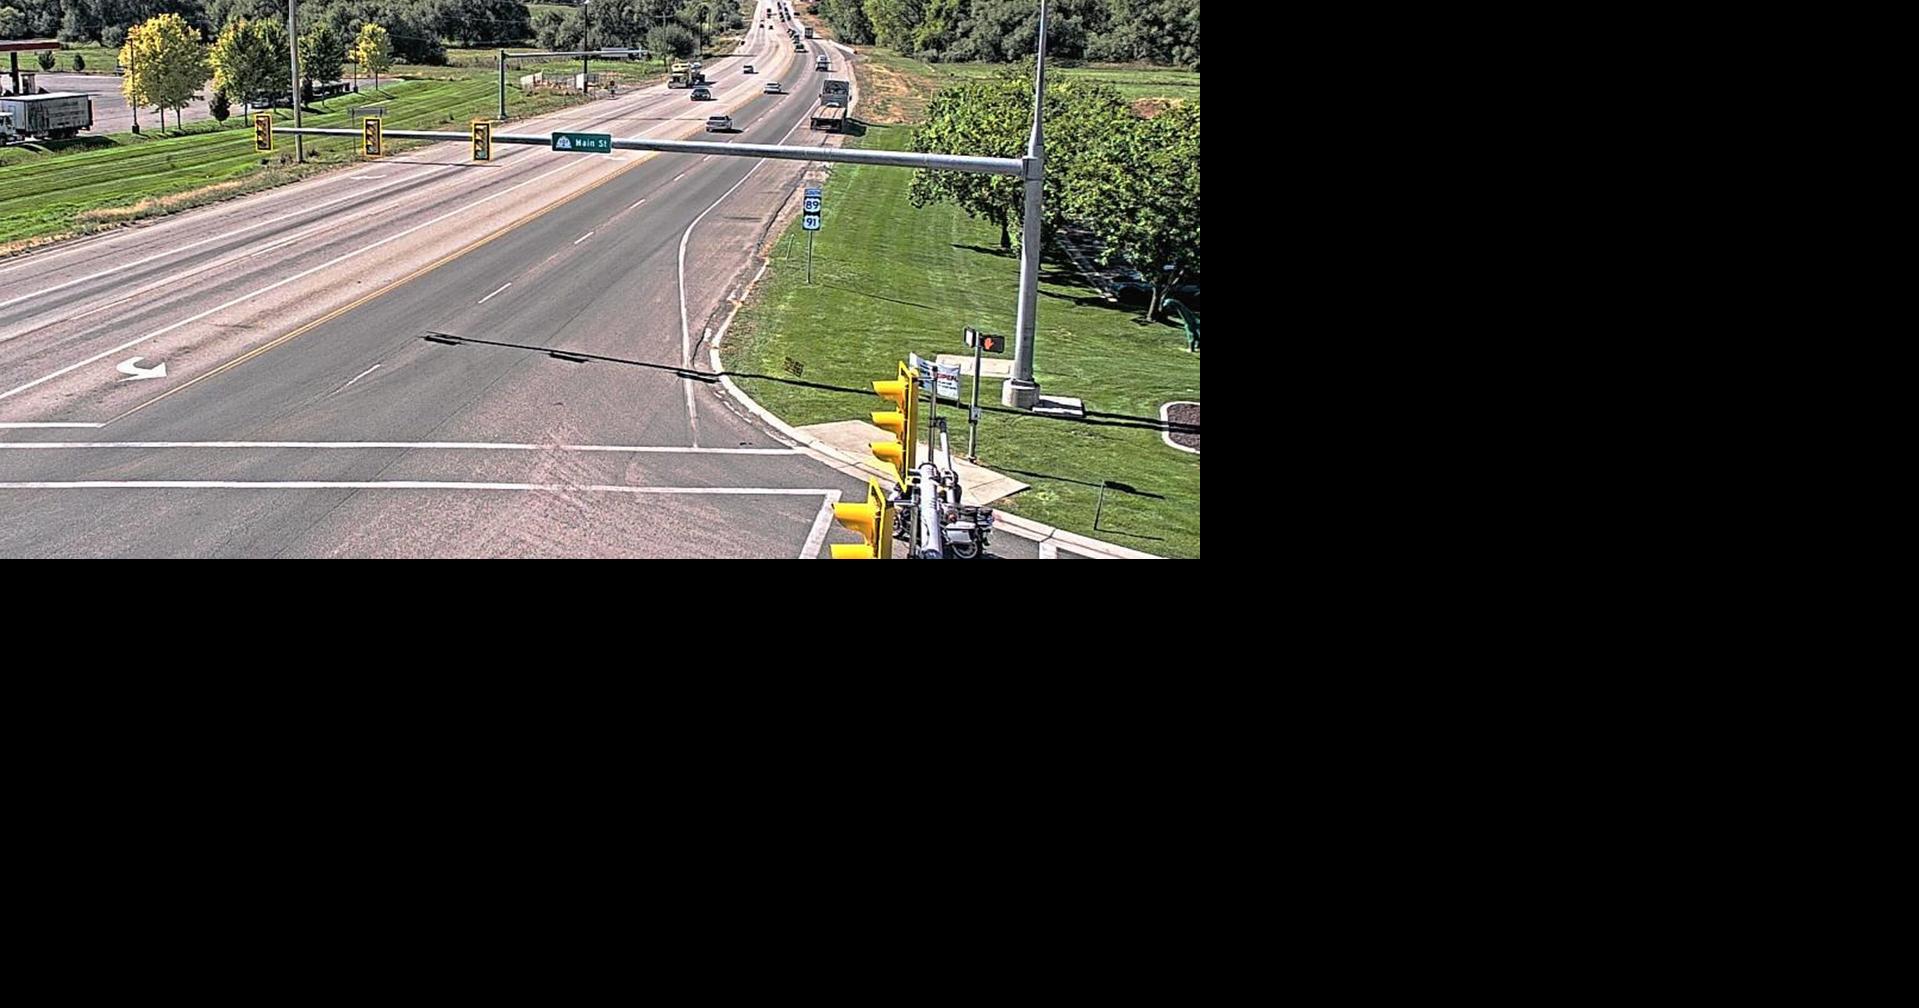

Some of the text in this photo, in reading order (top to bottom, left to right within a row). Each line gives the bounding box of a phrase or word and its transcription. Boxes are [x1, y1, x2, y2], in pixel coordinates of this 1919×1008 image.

[575, 138, 607, 148] Main St
[806, 200, 819, 210] 89
[806, 217, 817, 227] 91
